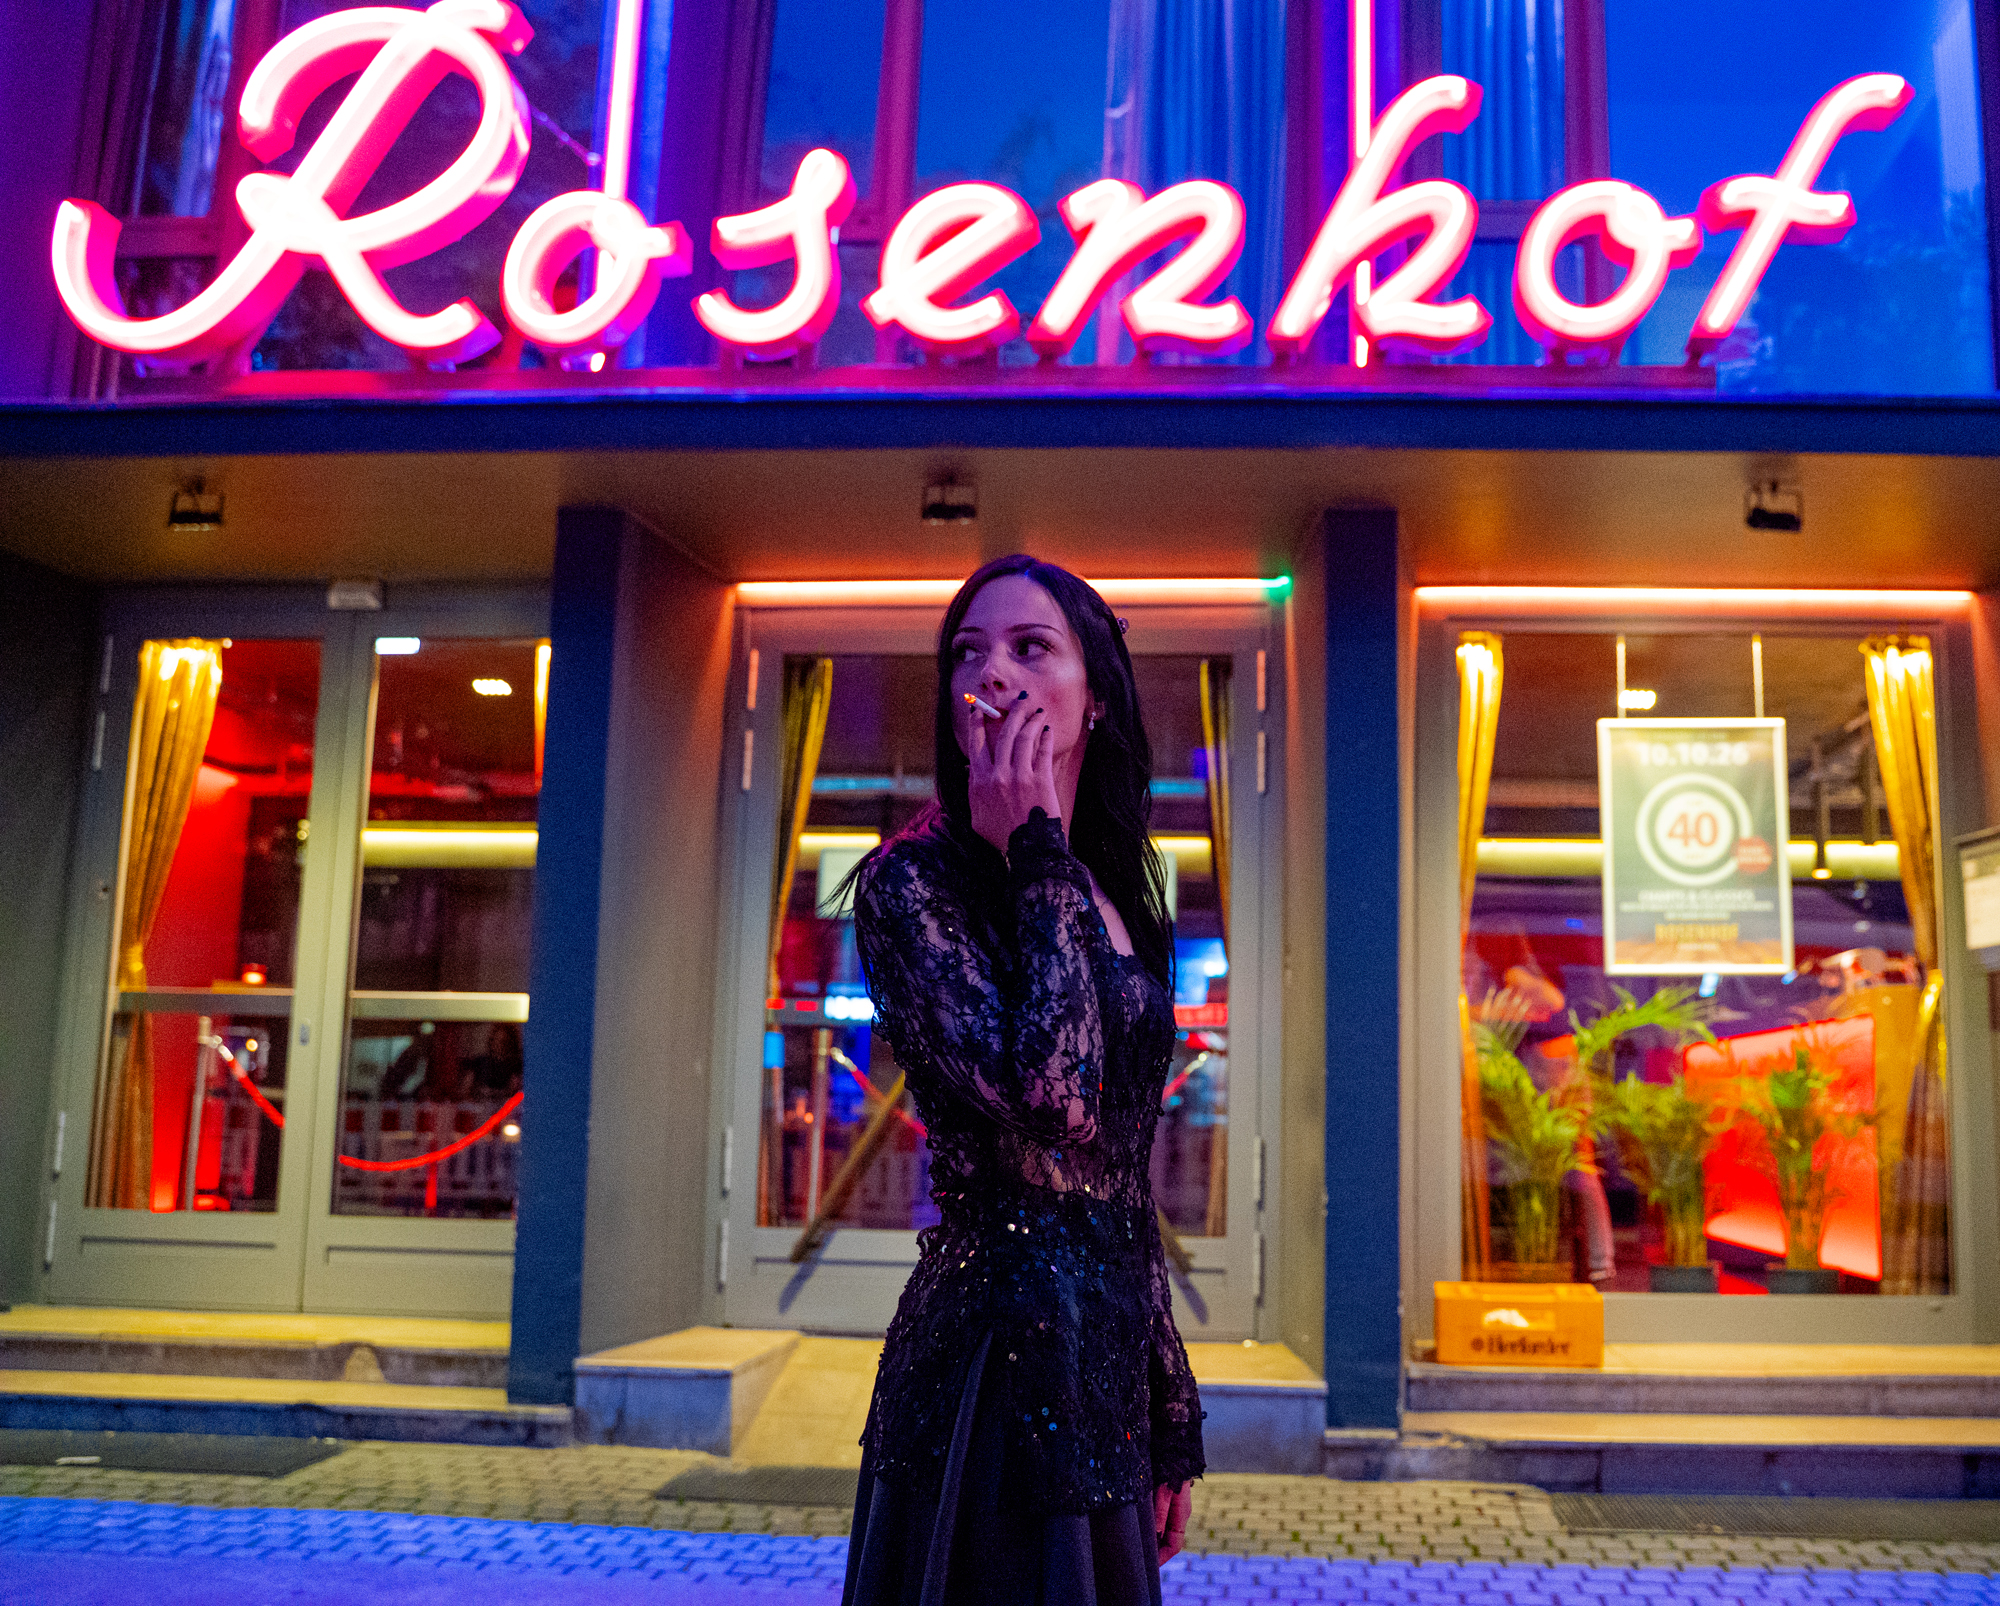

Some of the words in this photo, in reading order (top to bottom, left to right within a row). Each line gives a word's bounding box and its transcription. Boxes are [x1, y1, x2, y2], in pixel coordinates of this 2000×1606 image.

[52, 0, 1914, 358] Rosenhof
[1636, 742, 1750, 766] 10.10.26
[1667, 811, 1720, 848] 40
